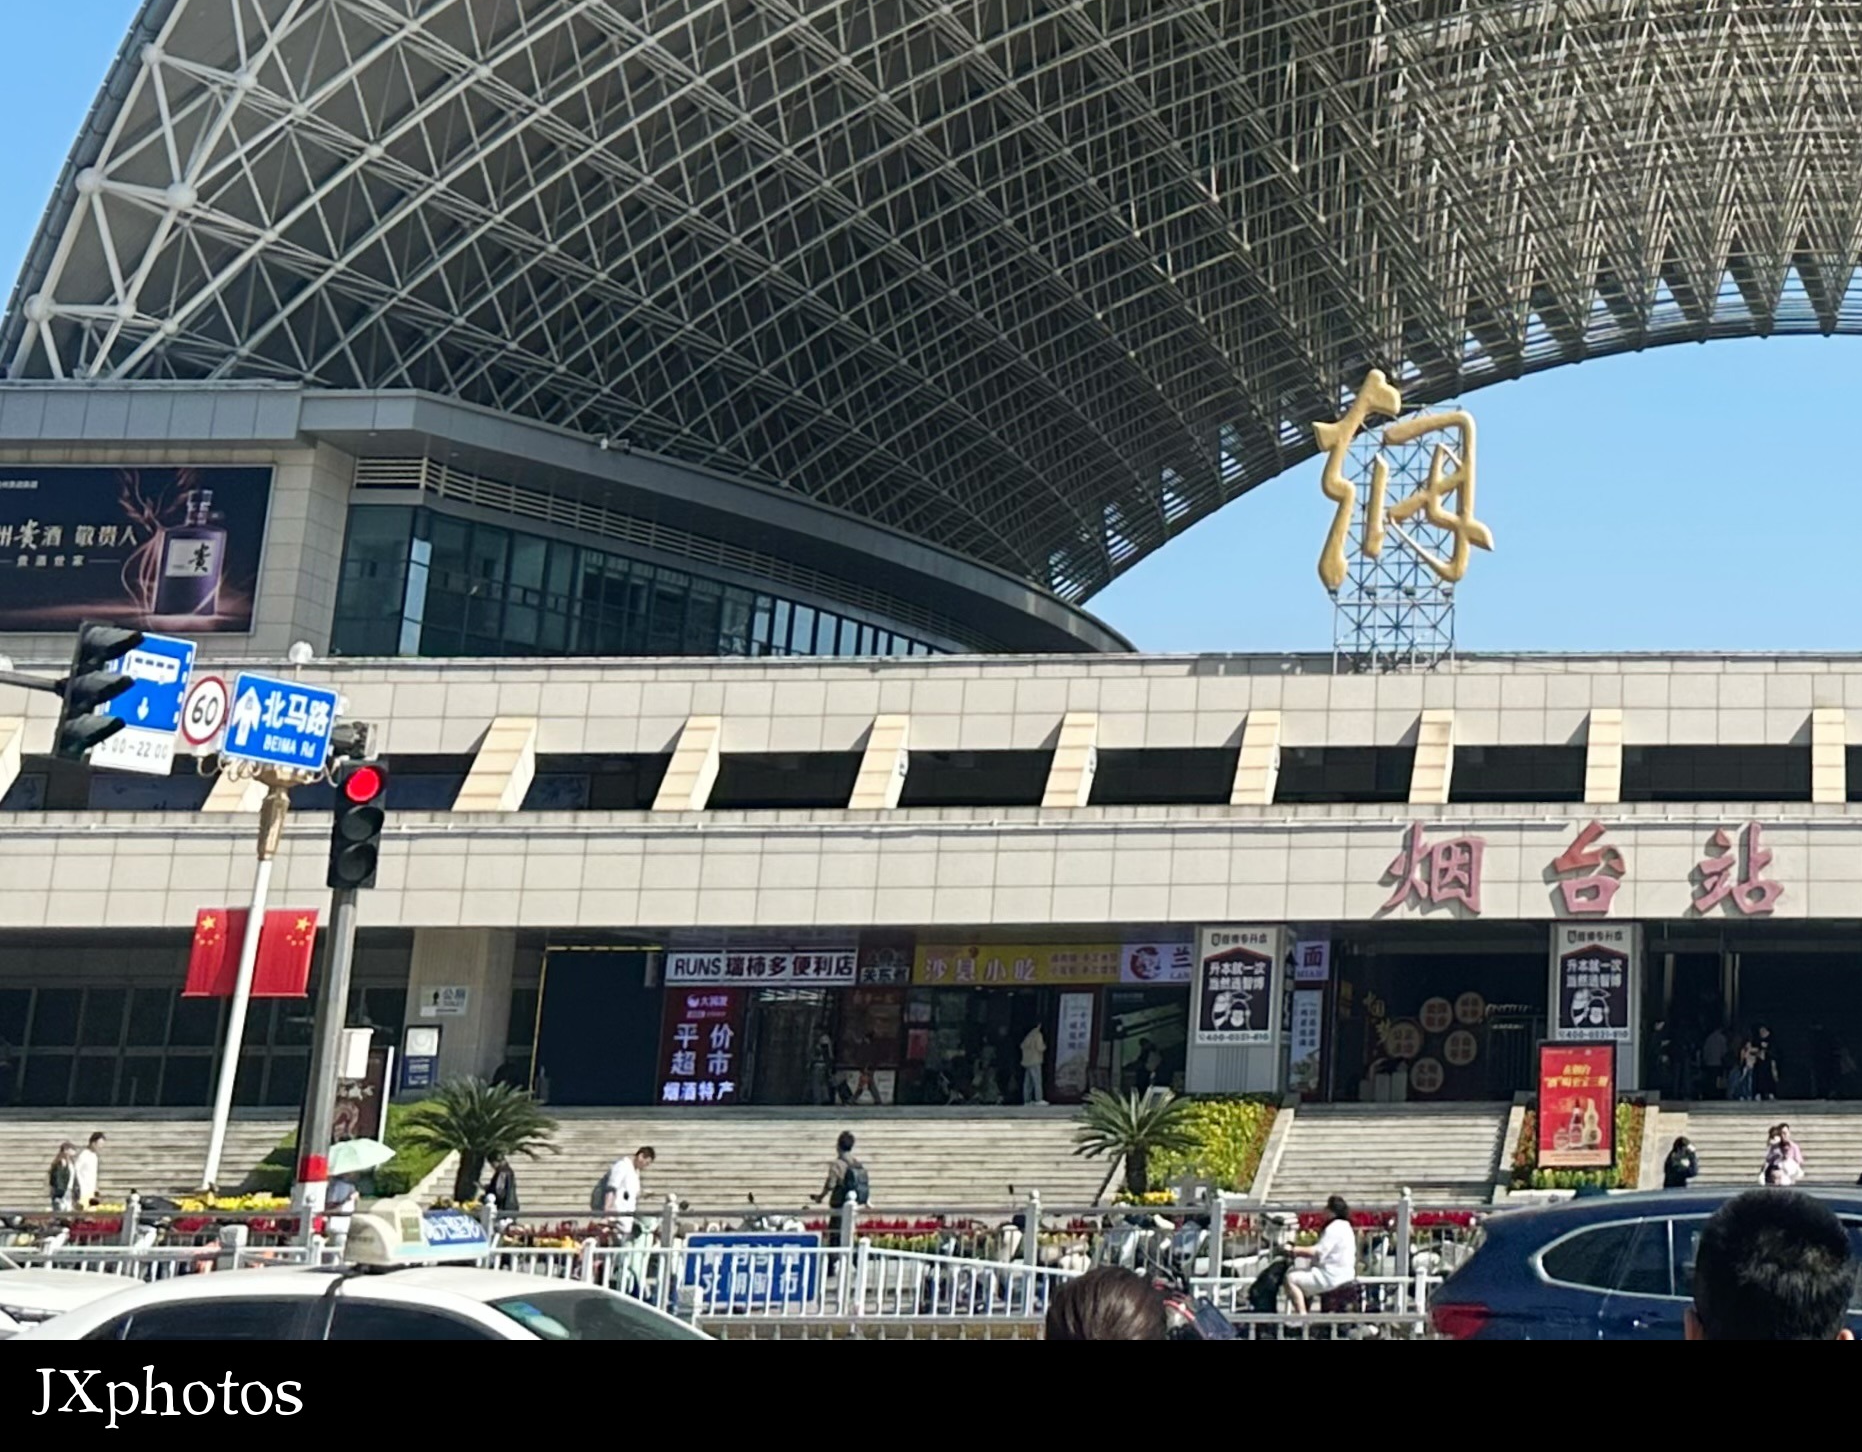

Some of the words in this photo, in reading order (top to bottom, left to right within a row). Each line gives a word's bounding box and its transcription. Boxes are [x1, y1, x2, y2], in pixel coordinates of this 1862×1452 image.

[75, 524, 138, 547] 敬贵人
[190, 696, 219, 726] 60
[261, 689, 331, 738] 北马路
[262, 734, 297, 756] BEIMA
[1382, 820, 1785, 916] 烟台站
[674, 957, 722, 977] RUNS
[1303, 945, 1324, 968] 面
[925, 958, 1036, 981] 沙县小吃
[673, 1023, 735, 1049] 平价
[670, 1050, 734, 1076] 超市
[662, 1080, 736, 1101] 烟酒特产
